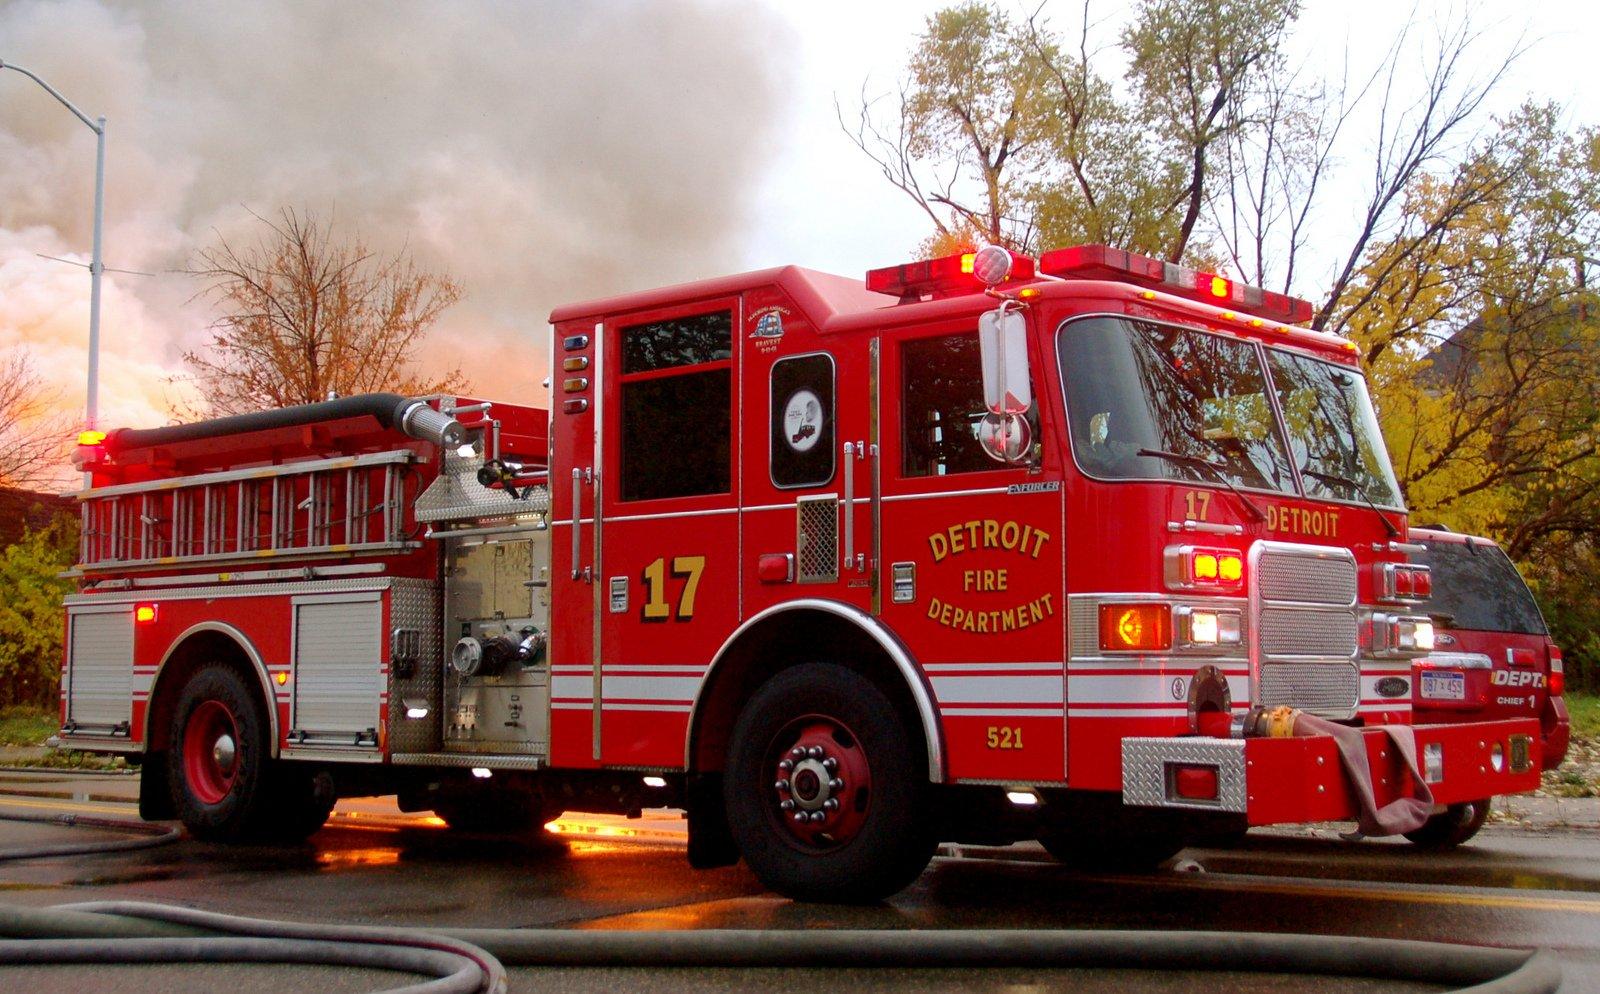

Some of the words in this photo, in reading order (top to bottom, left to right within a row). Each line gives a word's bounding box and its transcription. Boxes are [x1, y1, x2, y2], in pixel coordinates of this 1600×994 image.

[1008, 481, 1059, 494] ENFORCER
[1185, 491, 1211, 521] 17
[1267, 505, 1339, 537] DETROIT
[928, 519, 1050, 562] DETROIT
[643, 556, 706, 619] 17
[964, 569, 1008, 592] FIRE
[927, 593, 1054, 633] DEPARTMENT
[1495, 670, 1543, 688] DEPT.
[1497, 696, 1525, 705] CHIEF
[1528, 695, 1536, 709] 1
[987, 726, 1024, 749] 521
